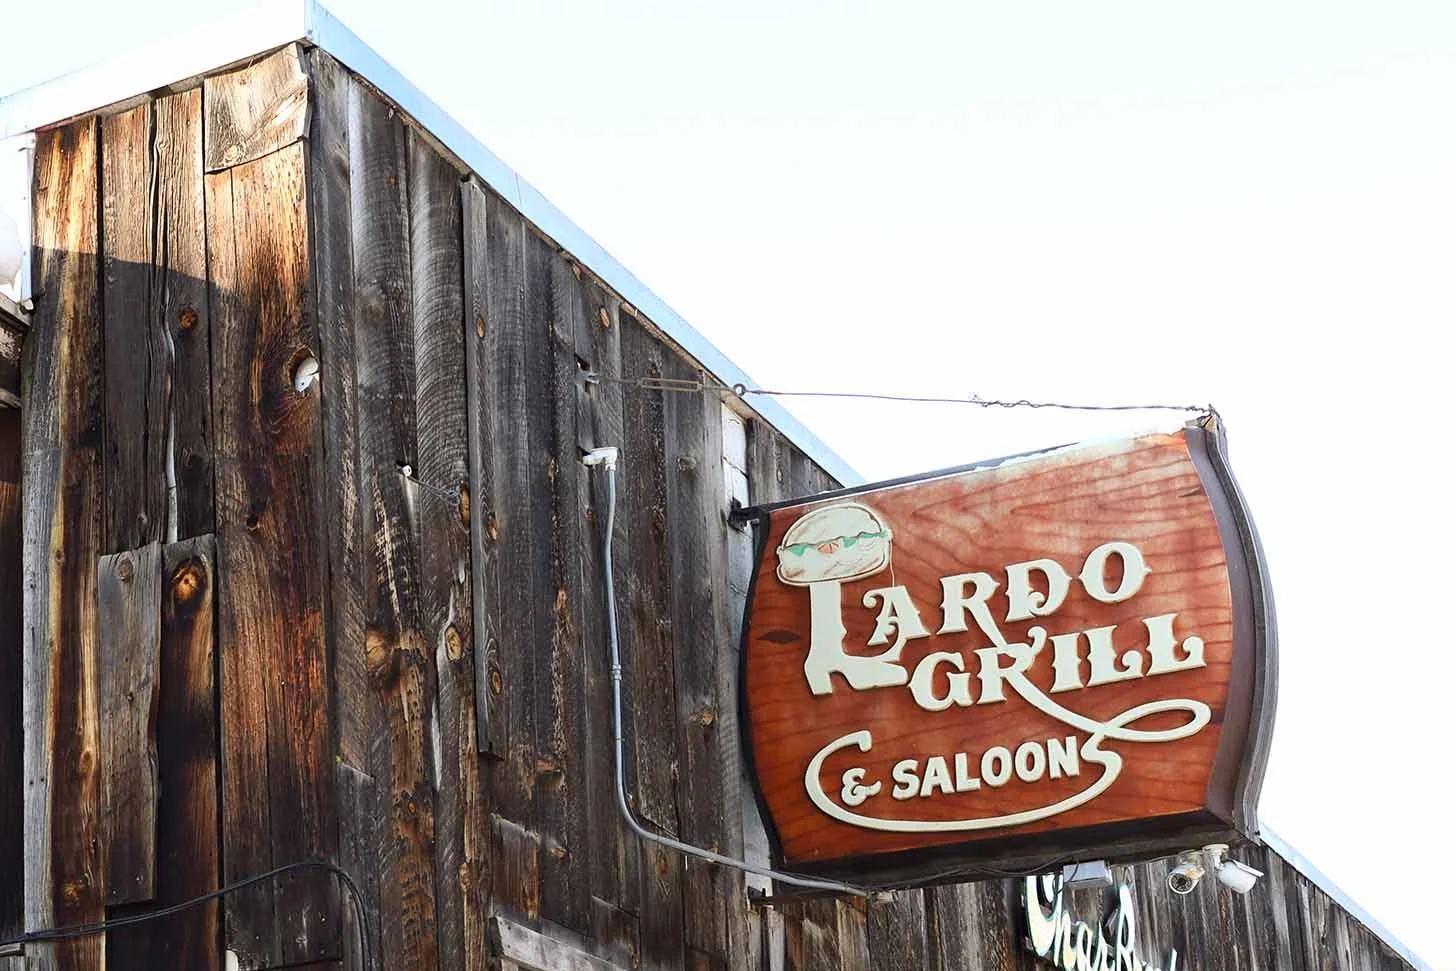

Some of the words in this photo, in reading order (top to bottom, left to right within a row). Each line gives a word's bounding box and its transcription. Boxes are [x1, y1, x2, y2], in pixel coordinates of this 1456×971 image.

[804, 541, 1151, 696] LARDO
[907, 612, 1207, 713] GRILL
[840, 768, 881, 807] &
[891, 735, 1080, 801] SALOON
